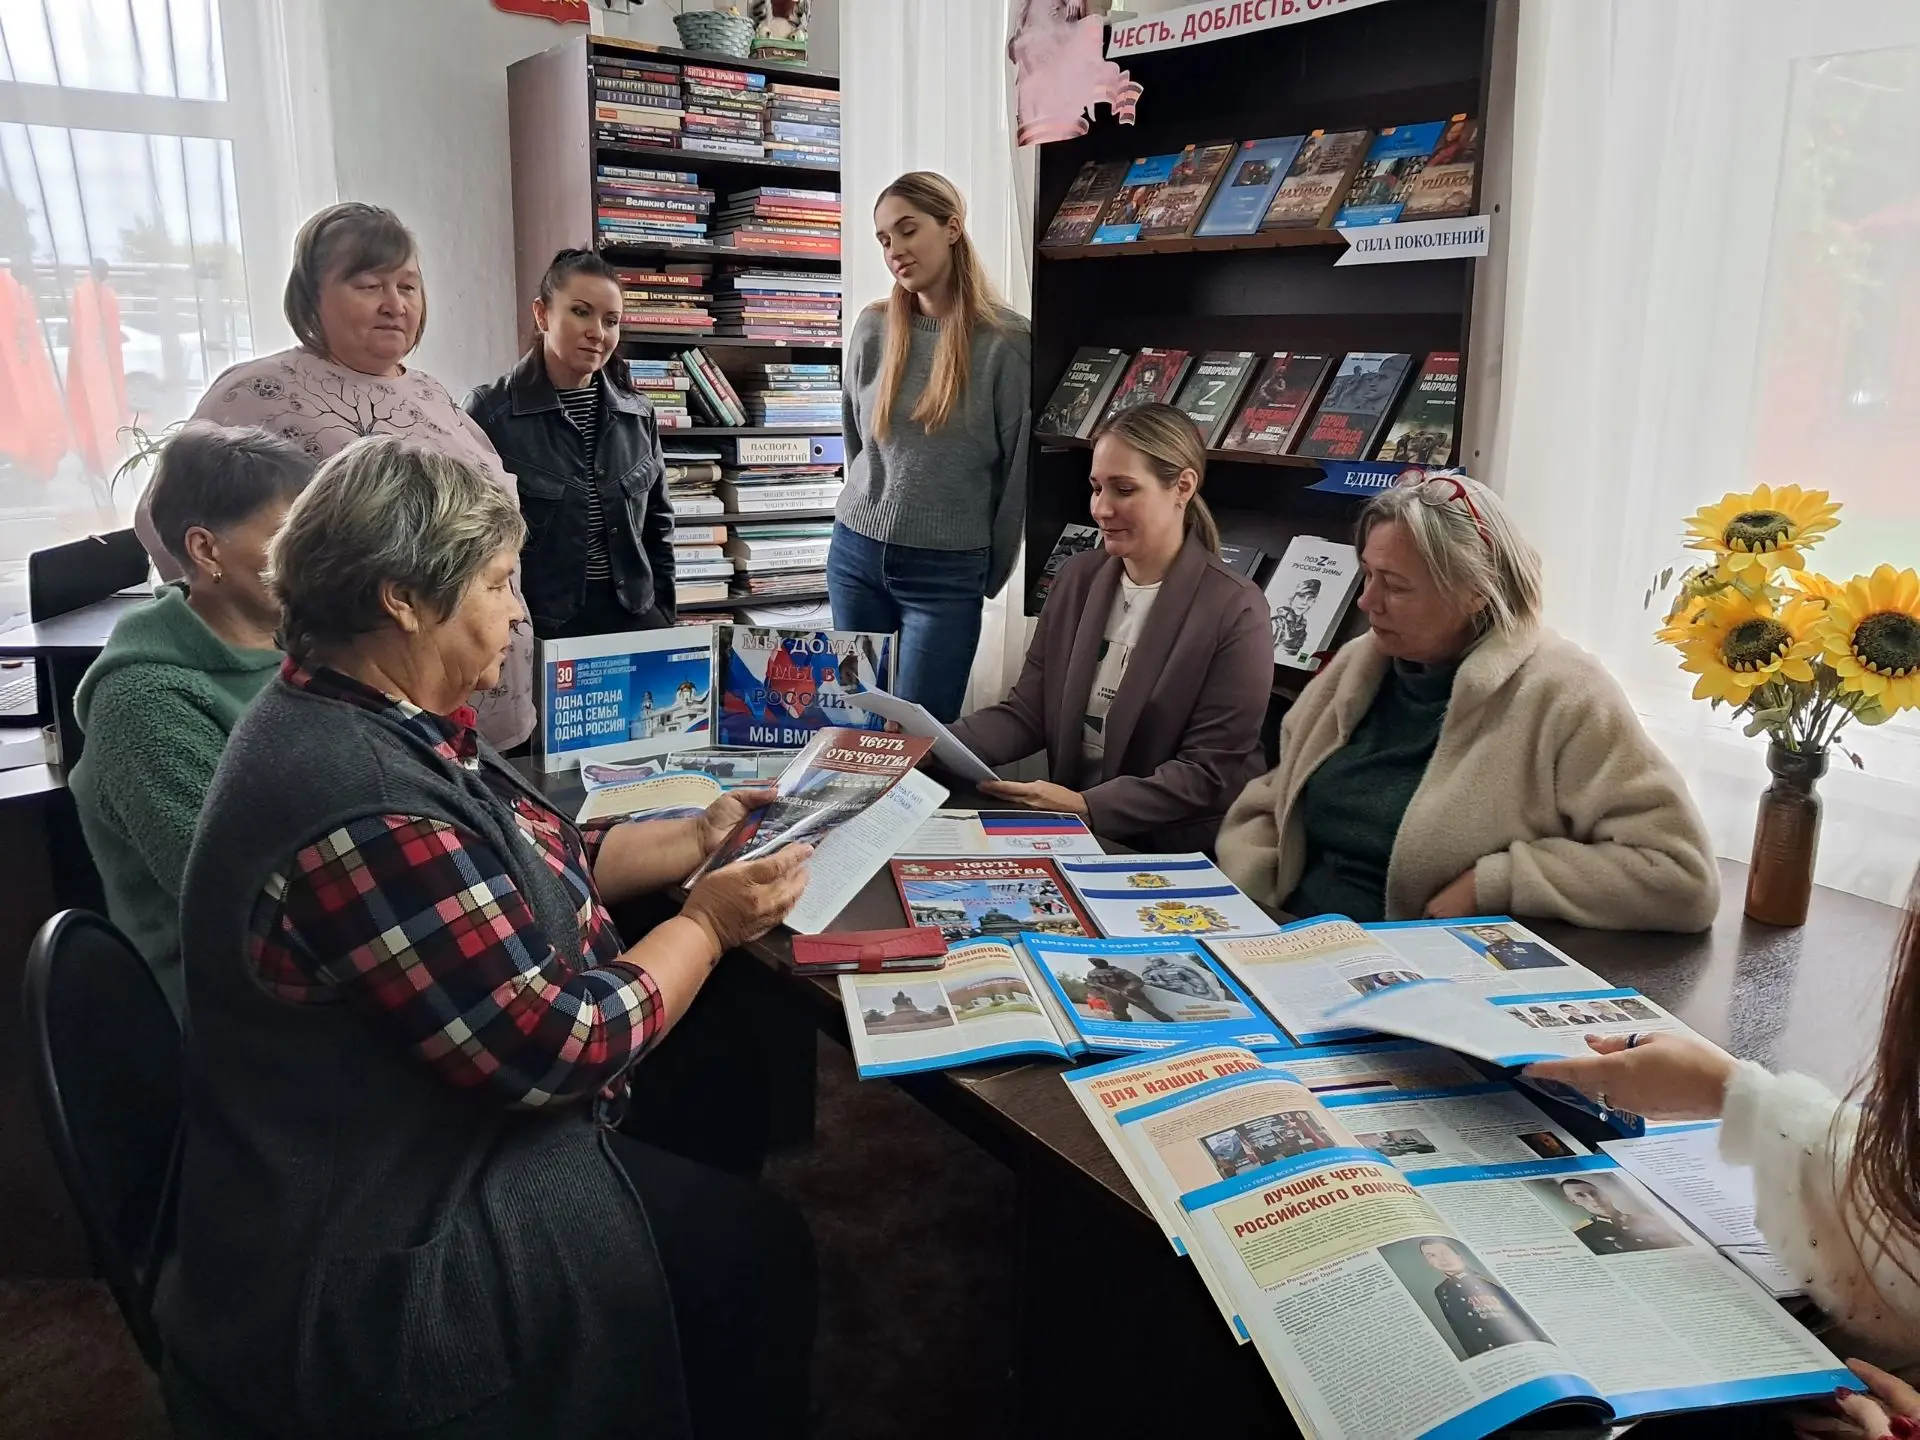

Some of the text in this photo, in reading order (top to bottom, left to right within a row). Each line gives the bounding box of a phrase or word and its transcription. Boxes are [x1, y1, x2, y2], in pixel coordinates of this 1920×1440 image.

[1113, 21, 1176, 49] ЧЕСТЬ.
[1421, 174, 1473, 190] УШАКО
[1279, 185, 1333, 199] НАХИМОВ
[625, 197, 695, 211] Великие битвы
[1355, 225, 1485, 253] СИЛА ПОКОЛЕНИЙ
[1197, 365, 1241, 376] НОВОРОССИЯ
[1434, 373, 1458, 382] ХАРЬКО
[1419, 381, 1457, 392] НАПРАВЛ
[751, 443, 798, 451] ПАСПОРТА
[742, 452, 808, 463] МЕРОПРИЯТИЙ
[1344, 471, 1399, 489] ЕДИНС
[742, 634, 783, 651] МЫ
[557, 666, 573, 682] 30
[770, 664, 835, 682] МЫ В
[555, 688, 623, 711] ОДНА СТРАНА
[753, 688, 853, 709] РОССИИ.
[555, 704, 619, 726] ОДНА СЕМЬЯ
[555, 718, 626, 741] ОДНА РОССИЯ!
[750, 726, 818, 745] МЫ ВМЕ
[859, 735, 905, 751] ЧЕСТЬ
[826, 748, 913, 767] ОТЕЧЕСТВА
[934, 867, 1048, 877] ОТЕЧЕСТВА
[955, 861, 1019, 869] ЧЕСТЬ
[946, 946, 1008, 960] тавитель
[1100, 1085, 1139, 1108] для
[1143, 1069, 1209, 1094] наших
[1263, 1166, 1383, 1206] ЛУЧШИЕ ЧЕРТЫ
[1234, 1187, 1349, 1237] РОССИЙСКОГО
